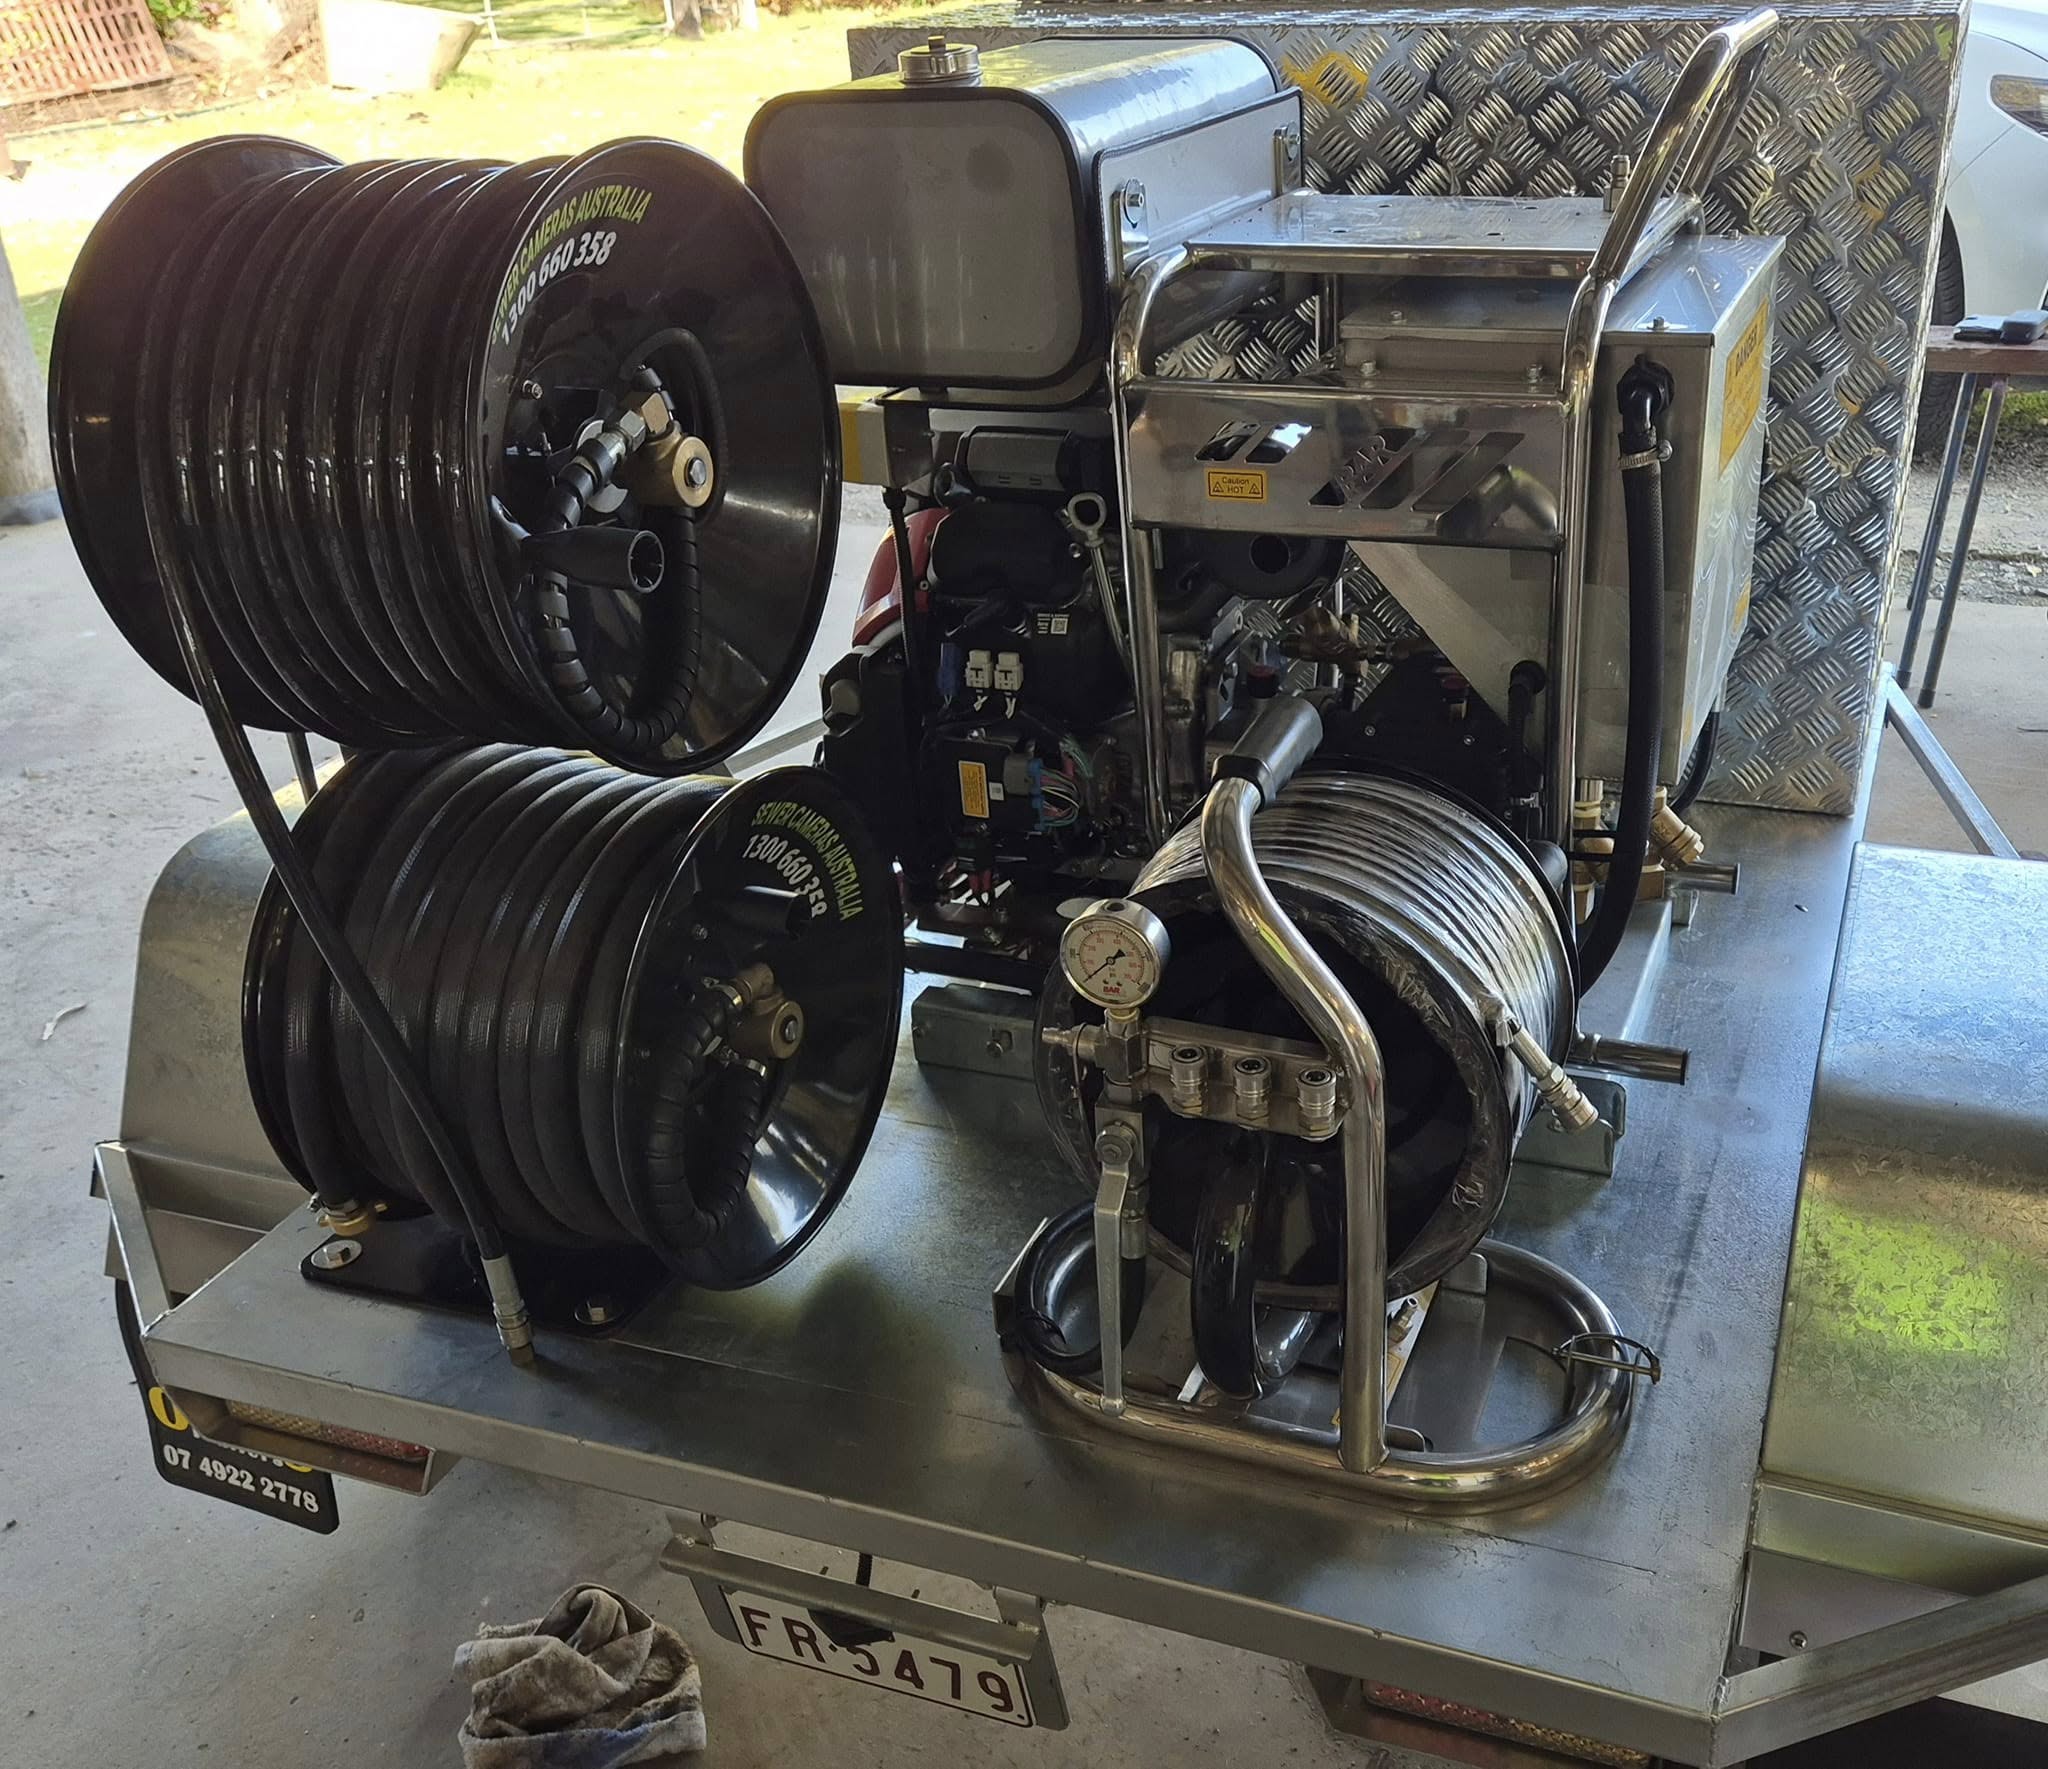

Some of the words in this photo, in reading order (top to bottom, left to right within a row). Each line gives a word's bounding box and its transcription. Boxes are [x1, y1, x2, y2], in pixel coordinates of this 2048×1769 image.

[520, 197, 577, 276] CAMERAS
[575, 184, 653, 225] AUSTRALIA
[501, 270, 536, 346] 1300
[538, 237, 575, 287] 660
[572, 231, 617, 266] 358
[1222, 476, 1250, 485] Caution
[1227, 486, 1244, 494] HOT
[742, 834, 789, 864] 1300
[776, 849, 813, 886] 660
[751, 801, 798, 827] SEWER
[787, 806, 841, 854] CAMERAS
[821, 843, 864, 921] AUSTRALIA
[1103, 986, 1121, 994] BAR
[163, 1444, 191, 1470] 07
[199, 1456, 256, 1492] 4922
[260, 1475, 320, 1514] 2778
